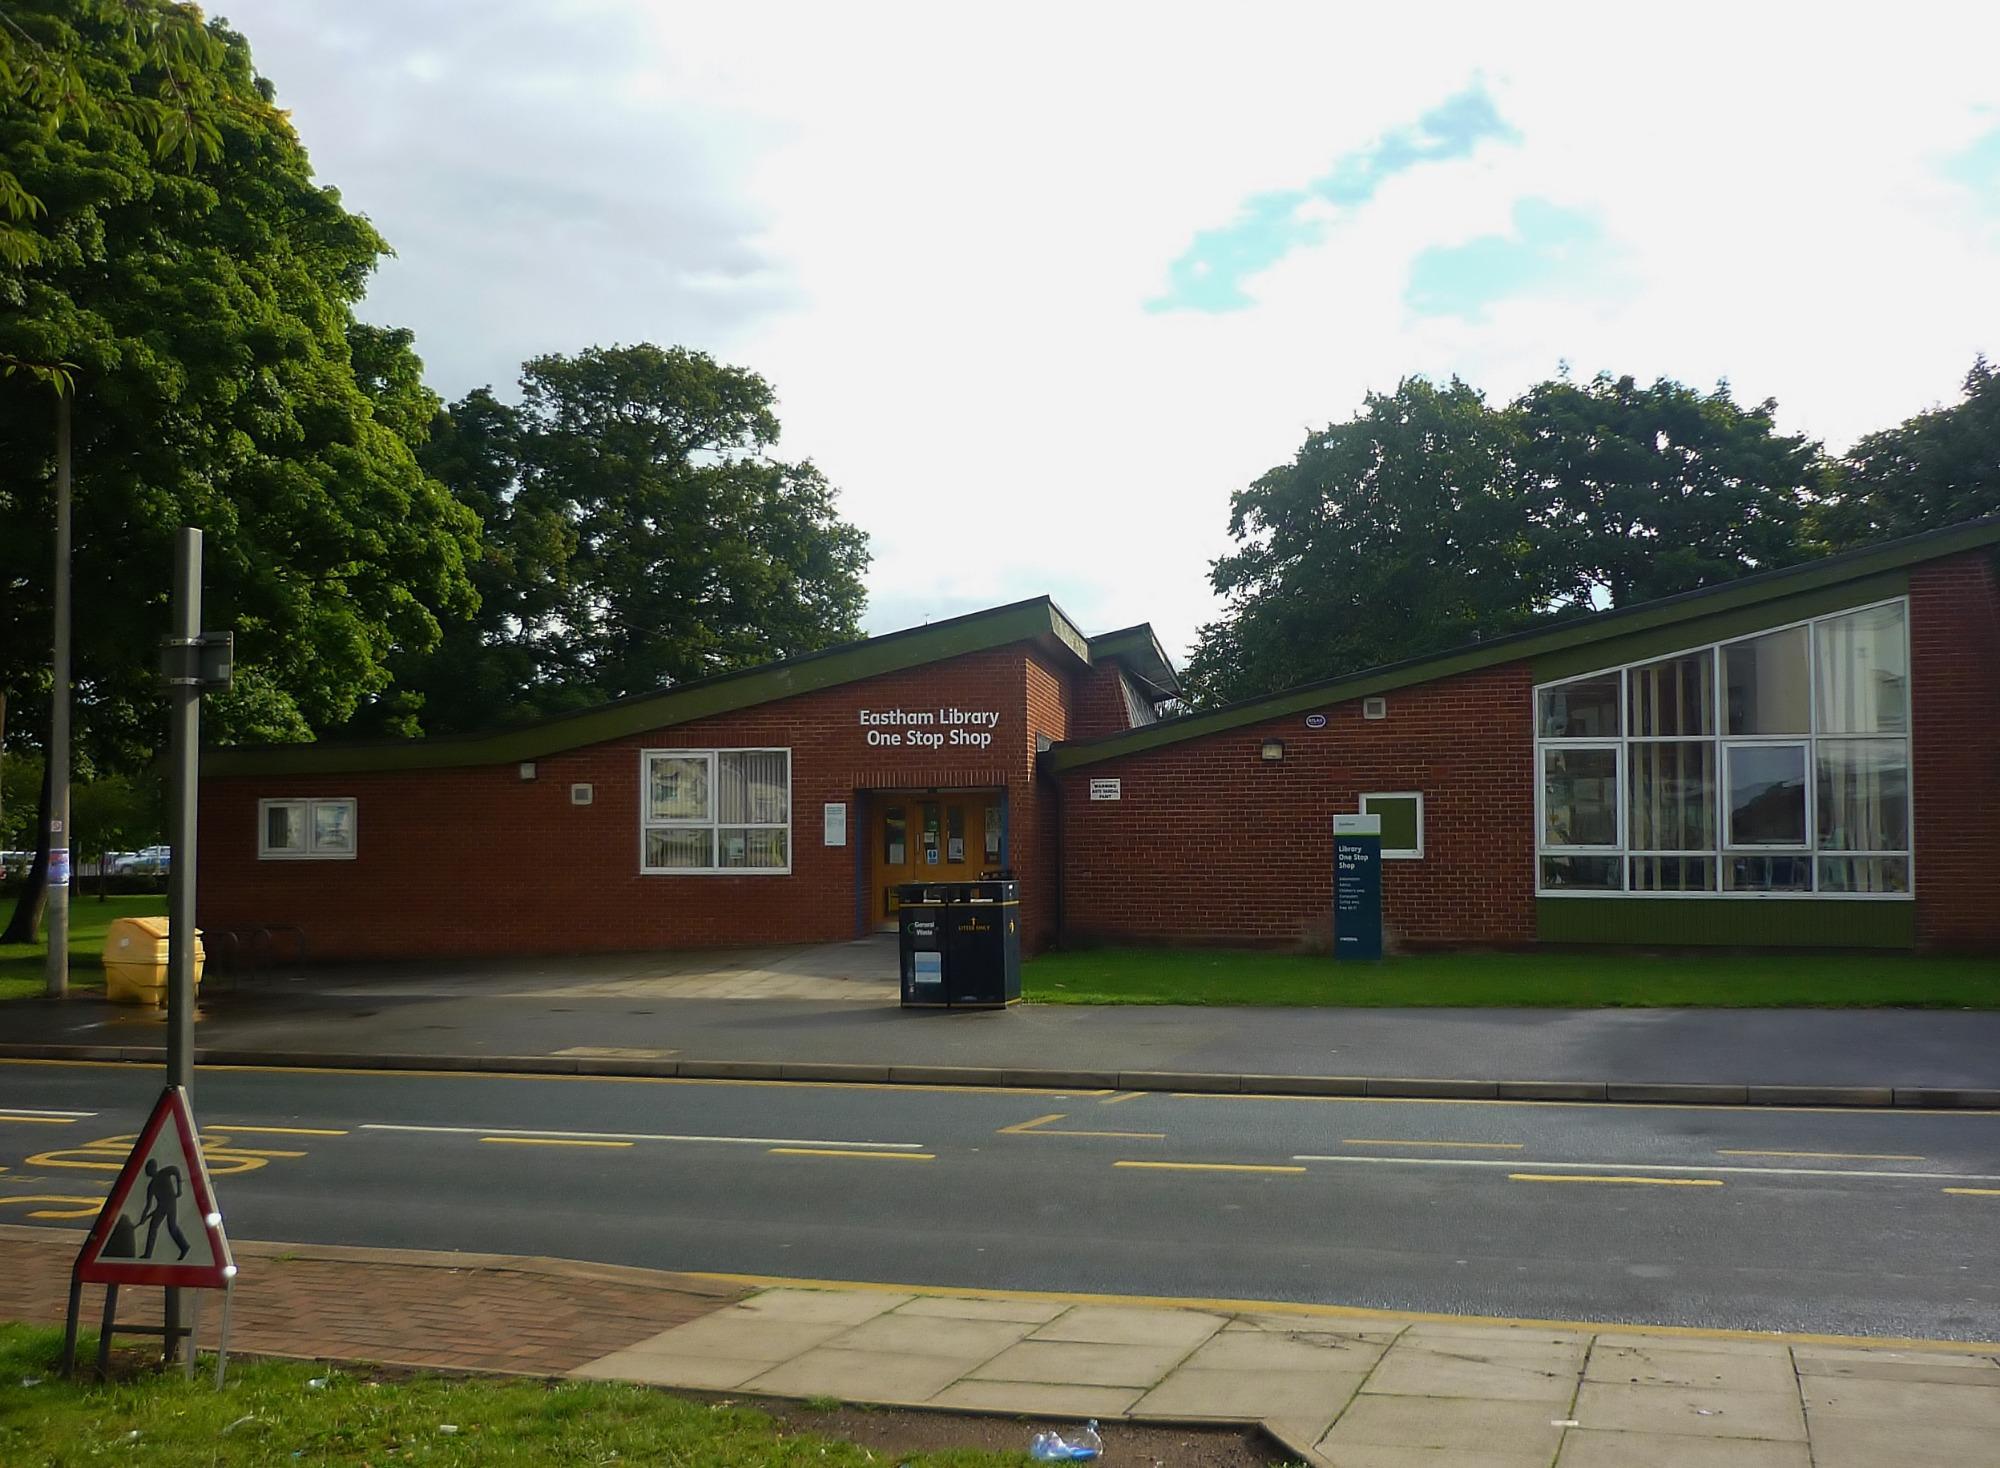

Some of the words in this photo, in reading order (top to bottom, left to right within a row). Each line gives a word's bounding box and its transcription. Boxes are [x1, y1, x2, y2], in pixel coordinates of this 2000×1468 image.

[860, 709, 934, 725] Eastham
[940, 708, 999, 728] Library
[867, 730, 901, 745] One
[906, 730, 944, 749] Stop
[949, 729, 991, 749] Shop
[1338, 845, 1362, 853] Library
[1353, 854, 1369, 862] Stop
[1338, 861, 1356, 870] Shop
